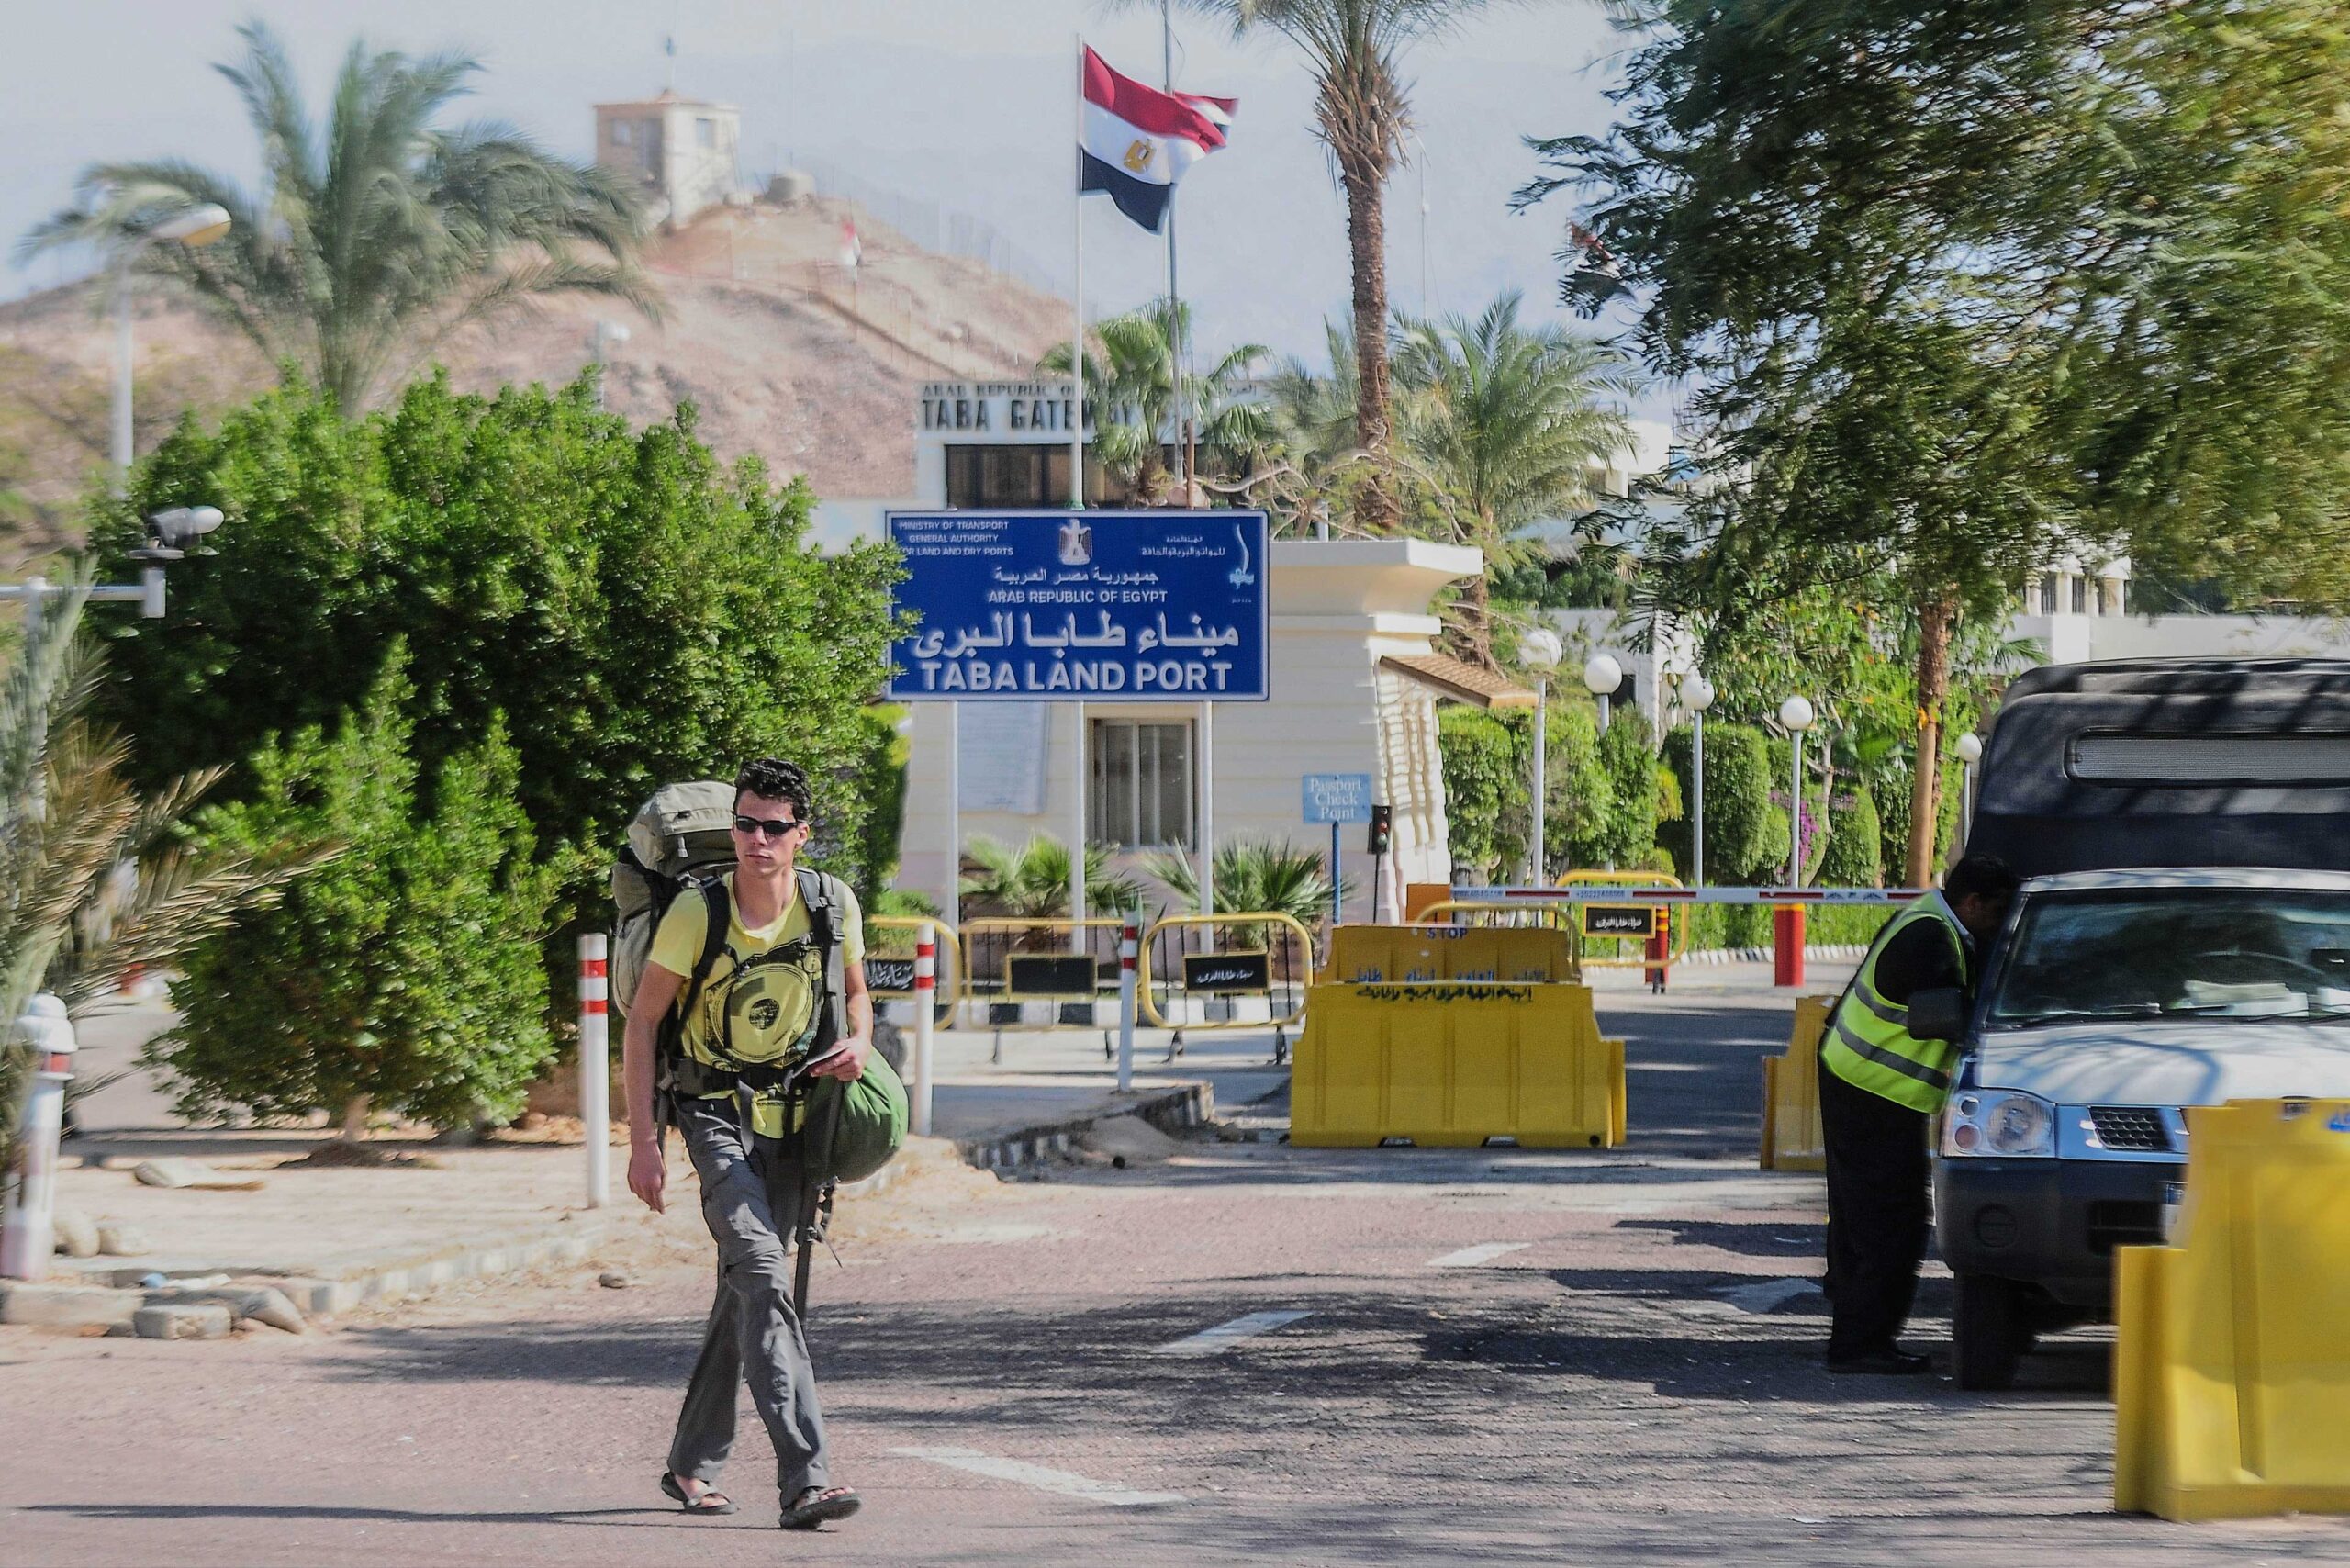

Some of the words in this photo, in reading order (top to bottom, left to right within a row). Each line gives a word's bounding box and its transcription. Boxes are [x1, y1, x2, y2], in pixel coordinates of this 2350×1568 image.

[976, 385, 1053, 397] REPUBLIC
[922, 399, 990, 431] TABA
[900, 521, 940, 530] MINISTRY
[942, 521, 954, 530] OF
[957, 521, 1009, 530] TRANSPORT
[909, 534, 948, 543] GENERAL
[950, 534, 999, 543] AUTHORITY
[897, 547, 915, 555] OR
[917, 547, 941, 555] LAND
[943, 547, 962, 555] AND
[963, 547, 981, 555] DRY
[984, 547, 1013, 555] PORTS
[994, 566, 1047, 586] العربية
[1053, 572, 1089, 585] مصر
[1093, 566, 1158, 586] جمهورية
[989, 590, 1025, 603] ARAB
[1029, 590, 1095, 603] REPUBLIC
[1100, 590, 1118, 603] OF
[1123, 590, 1169, 603] EGYPT
[1024, 610, 1126, 659] طابا
[1137, 610, 1239, 657] ميناء
[920, 661, 1019, 691] TABA
[1028, 661, 1126, 691] LAND
[1136, 661, 1233, 691] PORT
[1309, 778, 1362, 793] Passport
[1315, 792, 1358, 806] Check
[1321, 807, 1355, 821] Point
[1427, 927, 1469, 940] STOP
